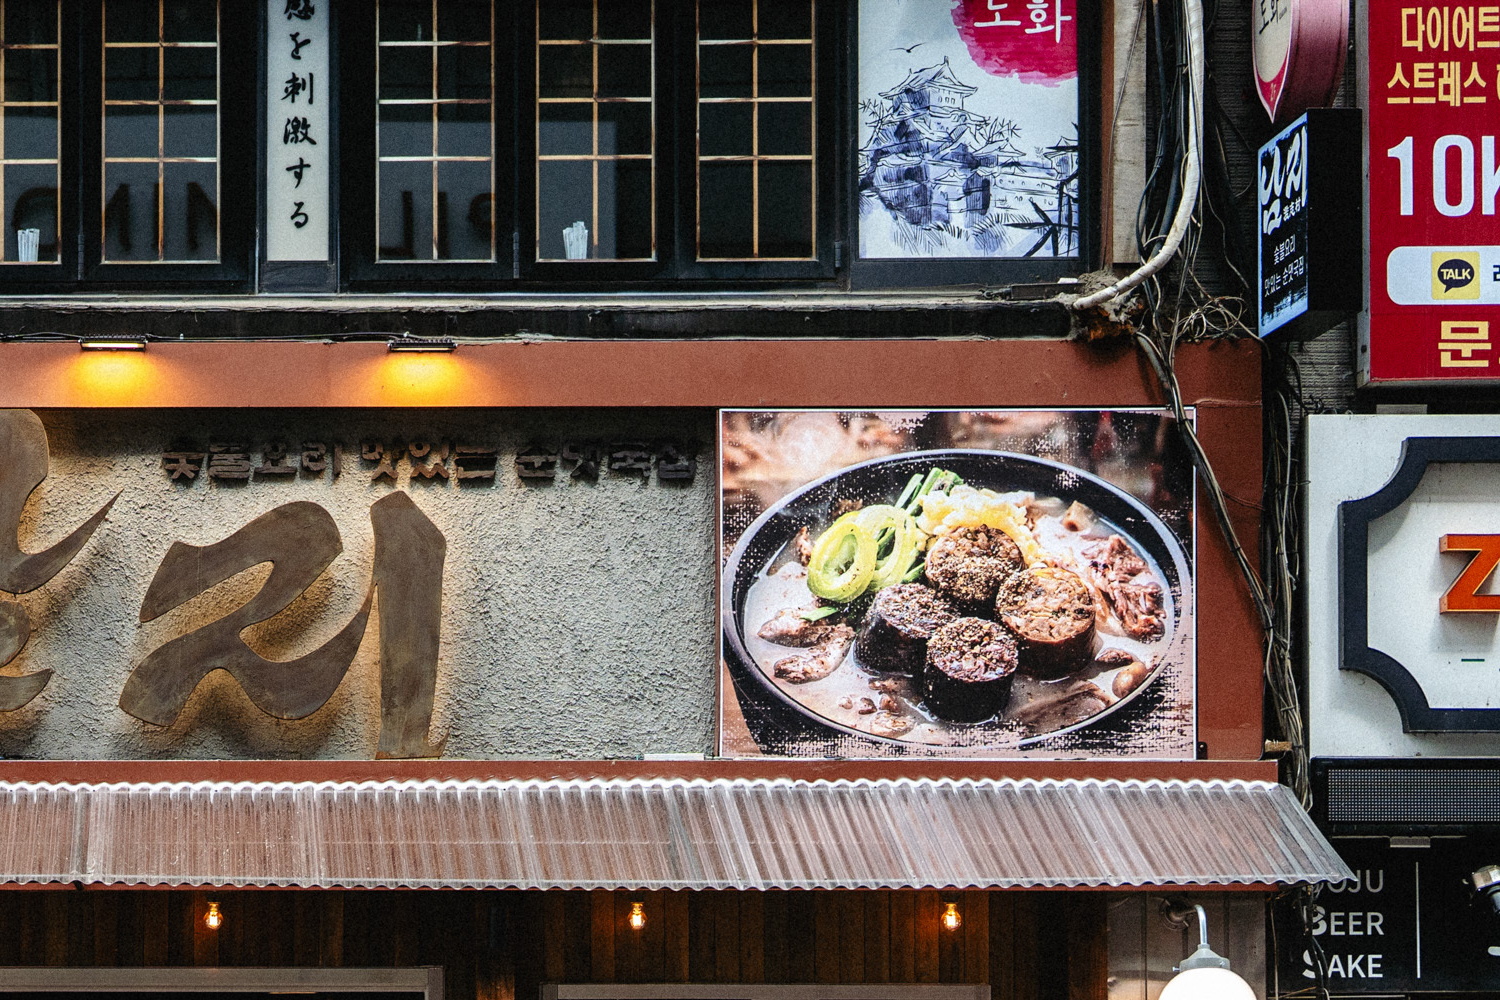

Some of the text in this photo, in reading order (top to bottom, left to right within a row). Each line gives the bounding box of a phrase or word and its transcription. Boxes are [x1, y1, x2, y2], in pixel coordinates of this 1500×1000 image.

[1402, 6, 1500, 51] 다이어트
[1387, 62, 1486, 106] 스트레스
[1264, 272, 1282, 297] 맛있는
[1440, 268, 1471, 280] TALK
[1438, 321, 1500, 367] 문
[1303, 906, 1385, 936] BEER
